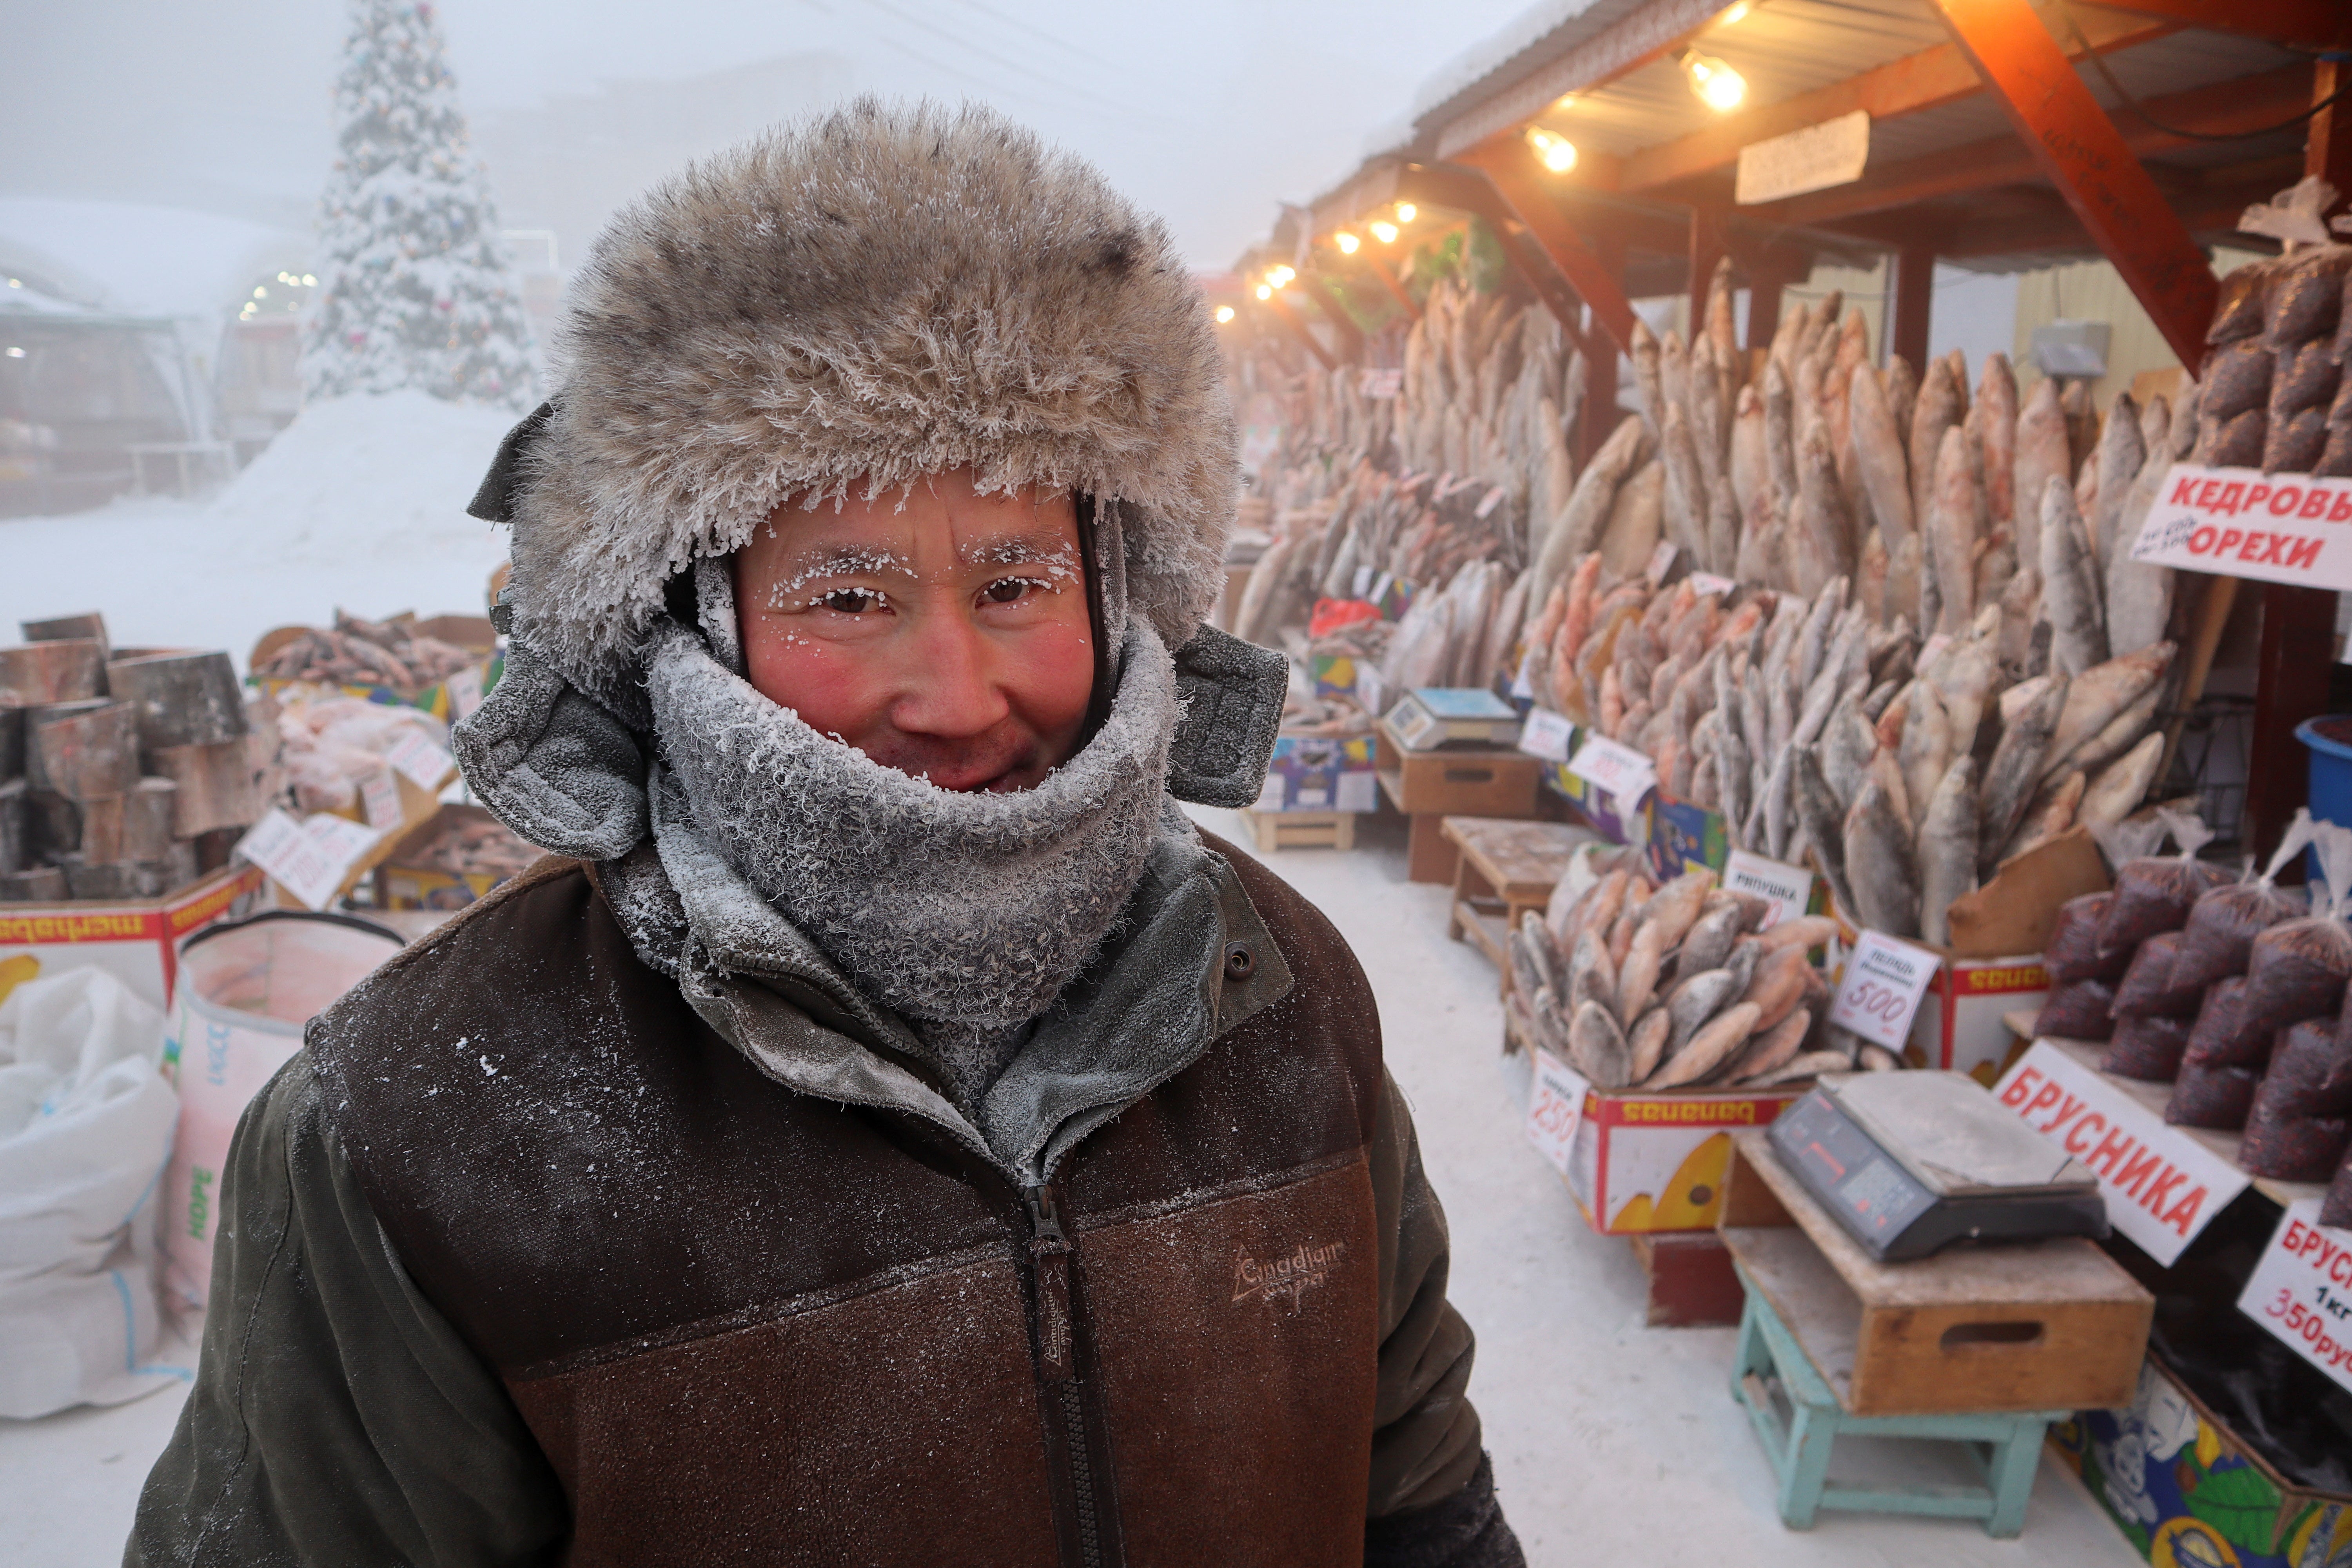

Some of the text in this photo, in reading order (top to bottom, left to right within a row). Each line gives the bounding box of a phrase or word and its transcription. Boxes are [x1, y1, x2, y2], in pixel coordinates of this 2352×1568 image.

[2188, 524, 2325, 570] ОРЕХИ
[1848, 982, 1907, 1023] 500
[1622, 1102, 1755, 1124] bananas
[2000, 1067, 2209, 1239] БРУСНИКА
